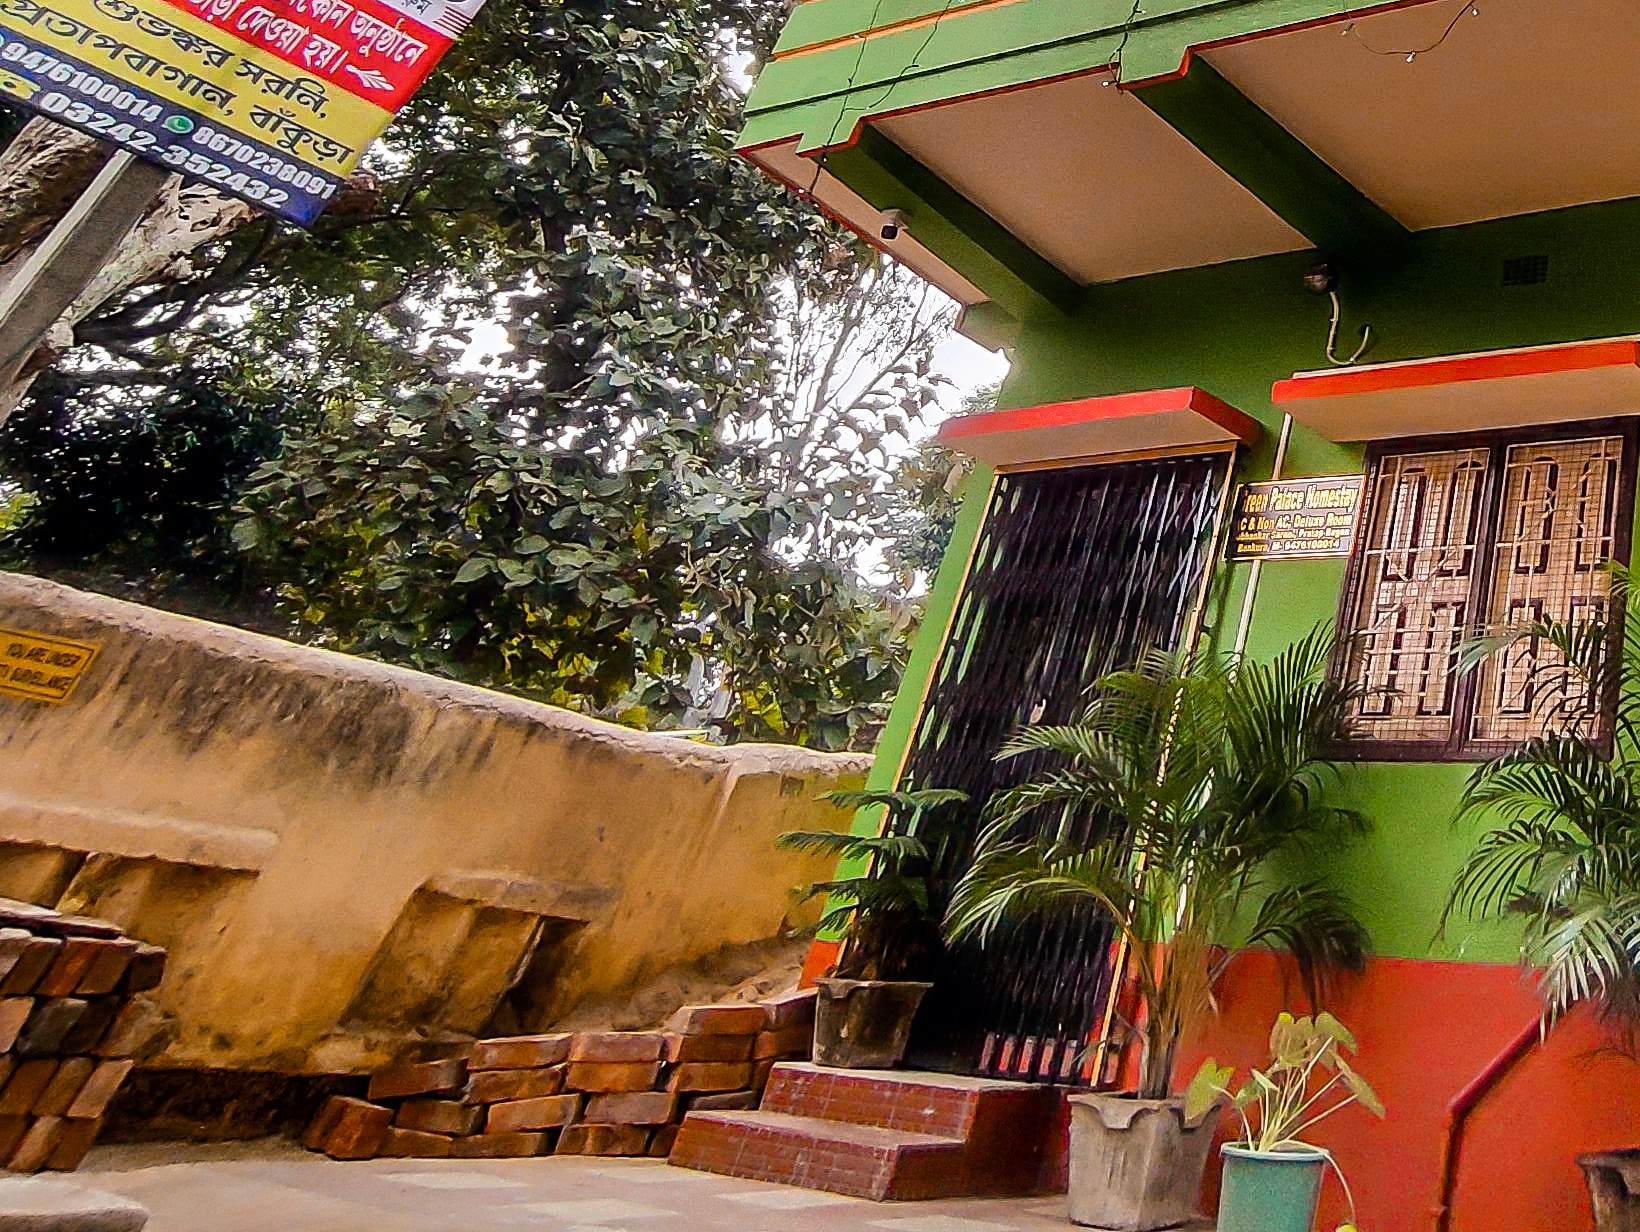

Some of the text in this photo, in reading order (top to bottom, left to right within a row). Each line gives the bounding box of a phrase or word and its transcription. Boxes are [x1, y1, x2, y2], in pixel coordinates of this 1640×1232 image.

[237, 5, 311, 56] দেওয়া
[350, 17, 429, 68] অনুষ্ঠানে
[235, 57, 331, 120] সরনি,
[2, 41, 337, 200] 9476100014 8670238091
[40, 91, 290, 210] 03242-352432
[249, 103, 355, 166] বাঁকুড়া
[1269, 486, 1304, 511] Palace
[1305, 484, 1358, 513] Homestay
